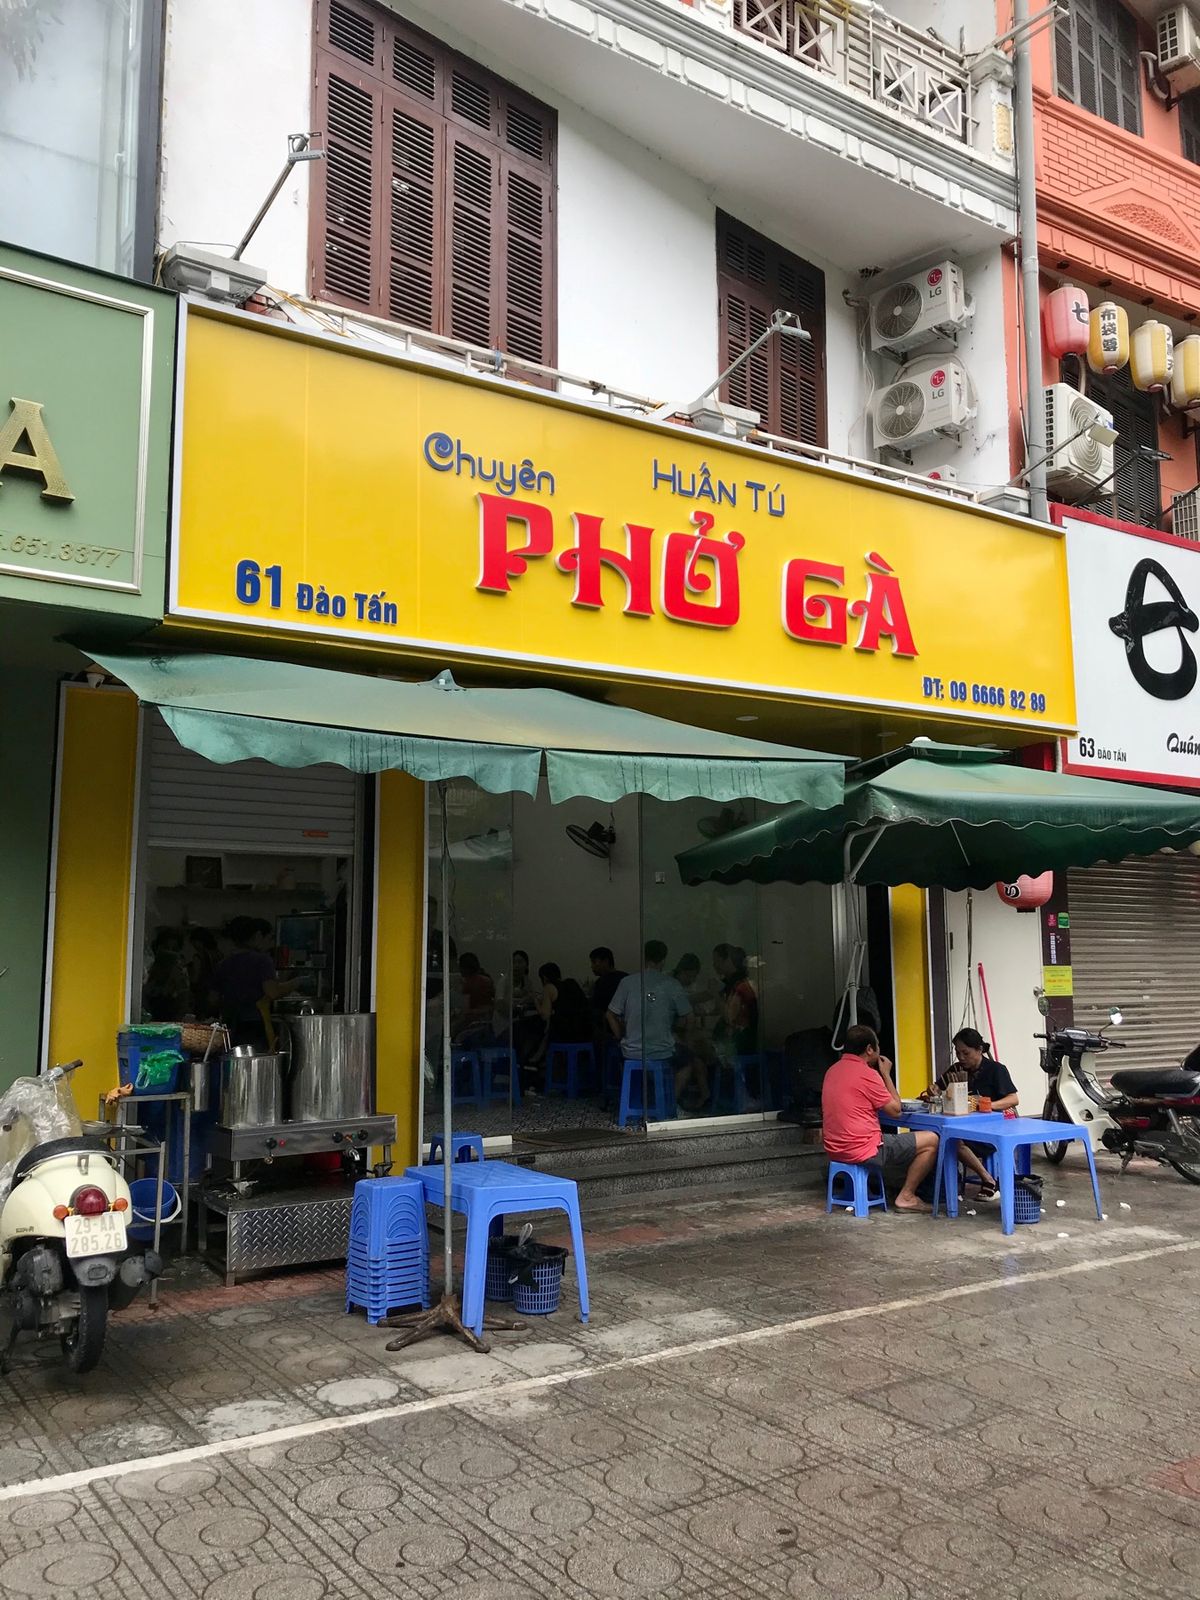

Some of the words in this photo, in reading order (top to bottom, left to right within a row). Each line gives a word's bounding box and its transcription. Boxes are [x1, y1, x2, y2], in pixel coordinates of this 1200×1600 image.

[929, 286, 942, 299] LG
[932, 388, 945, 400] LG
[423, 432, 555, 496] Chuyên
[745, 480, 785, 517] TÚ
[0, 533, 120, 568] .651.3377
[475, 492, 746, 628] PHỞ
[781, 551, 919, 657] GÀ
[236, 559, 282, 609] 61
[296, 582, 347, 619] Đào
[353, 591, 398, 626] Tấn
[922, 675, 945, 699] ĐT:
[950, 680, 967, 702] 09
[972, 683, 1005, 708] 6666
[1010, 689, 1026, 710] 82
[1030, 692, 1046, 713] 89
[1079, 737, 1095, 758] 63
[1097, 747, 1112, 761] ĐÀO
[75, 1214, 116, 1235] 29-AA
[71, 1232, 122, 1255] 285.26
